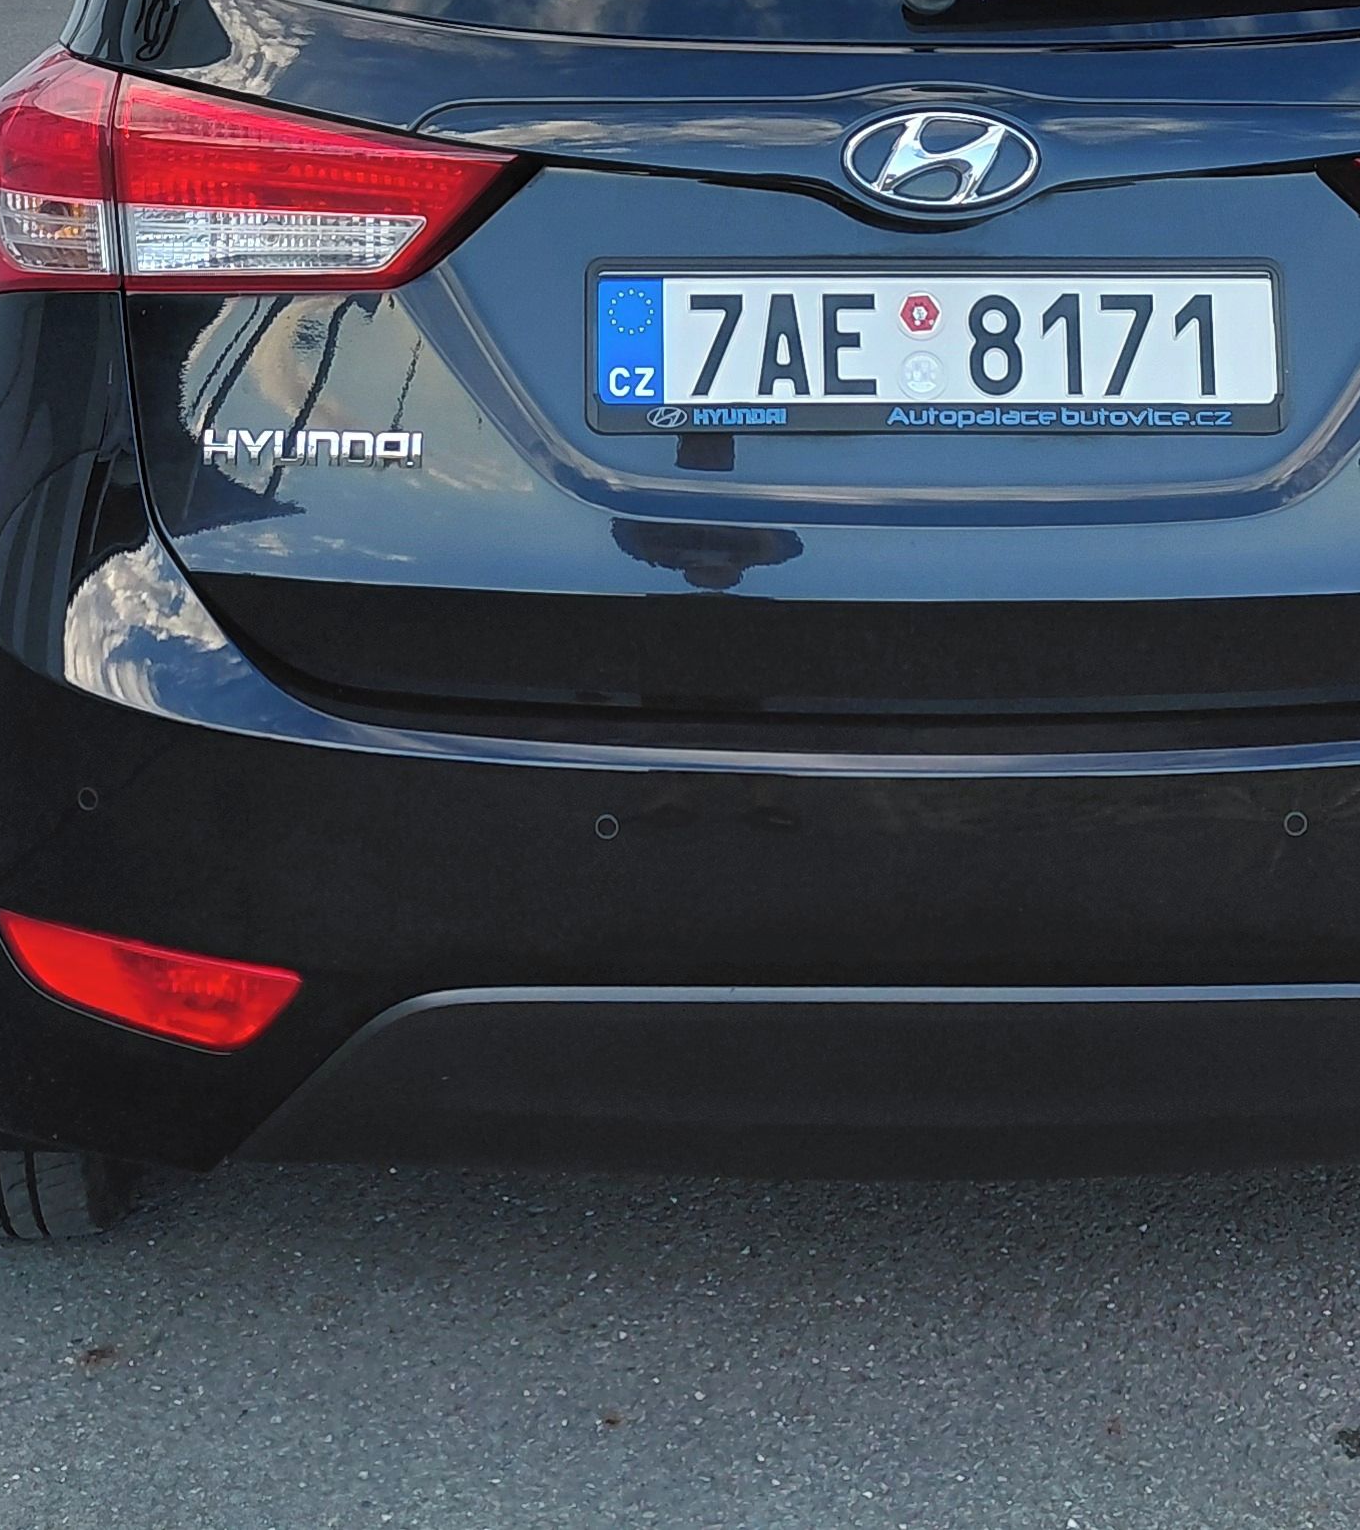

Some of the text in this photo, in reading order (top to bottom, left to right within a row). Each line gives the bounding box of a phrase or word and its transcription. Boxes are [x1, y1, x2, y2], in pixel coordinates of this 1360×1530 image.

[687, 293, 1217, 397] 7AE 8171
[608, 368, 656, 397] CZ
[693, 407, 787, 425] HYUNDAI
[887, 406, 1233, 429] Autopalace butovice.cz
[203, 429, 423, 466] HYUNDAI
